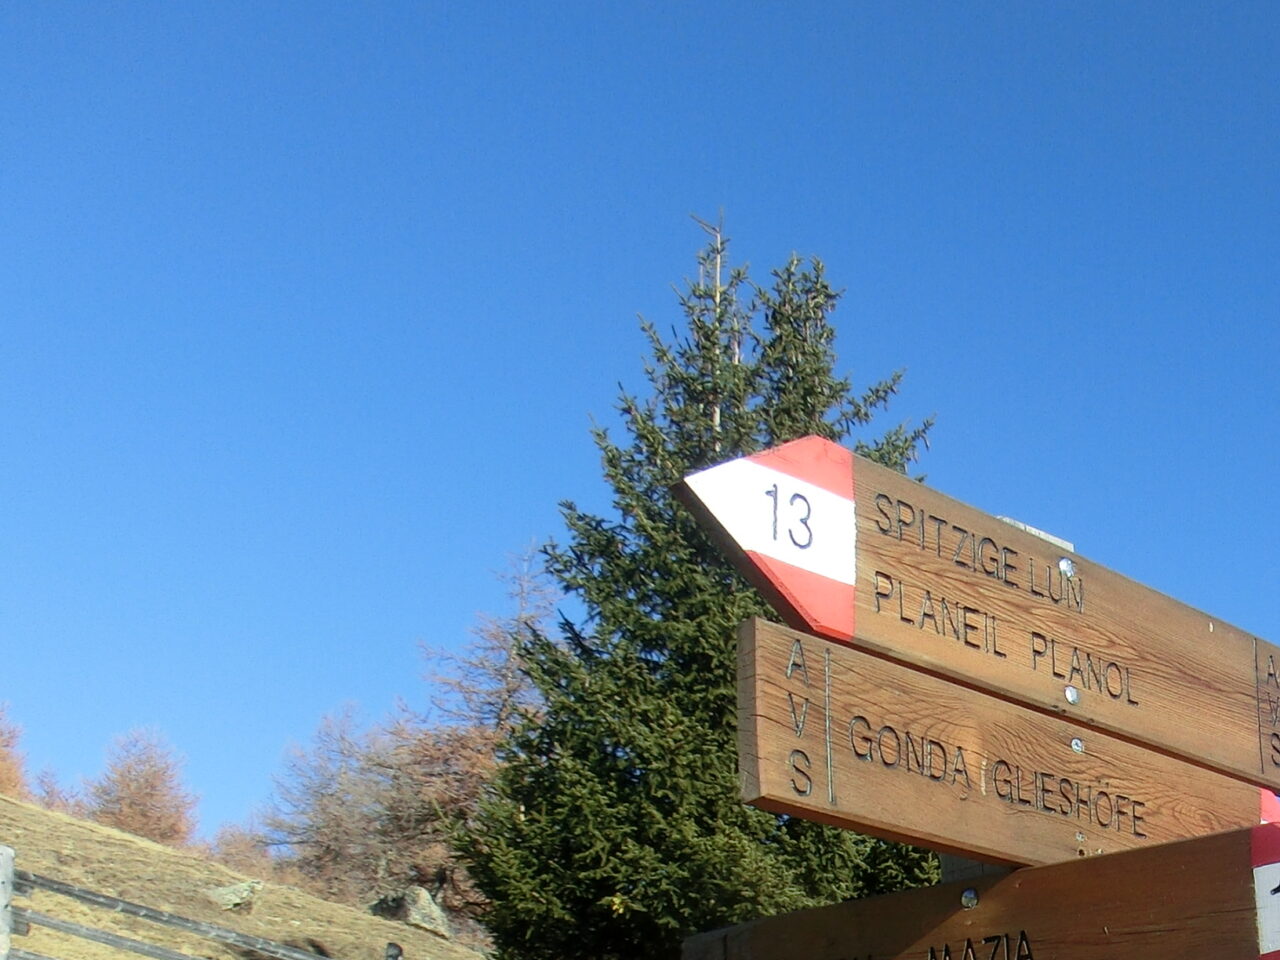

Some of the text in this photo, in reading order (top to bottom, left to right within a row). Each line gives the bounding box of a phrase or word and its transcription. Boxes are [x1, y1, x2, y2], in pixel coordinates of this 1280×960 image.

[765, 483, 813, 549] 13
[873, 492, 1019, 590] SPITZIGE
[874, 570, 1139, 706] PLANEIL PLANOL
[848, 715, 968, 788] GONDA
